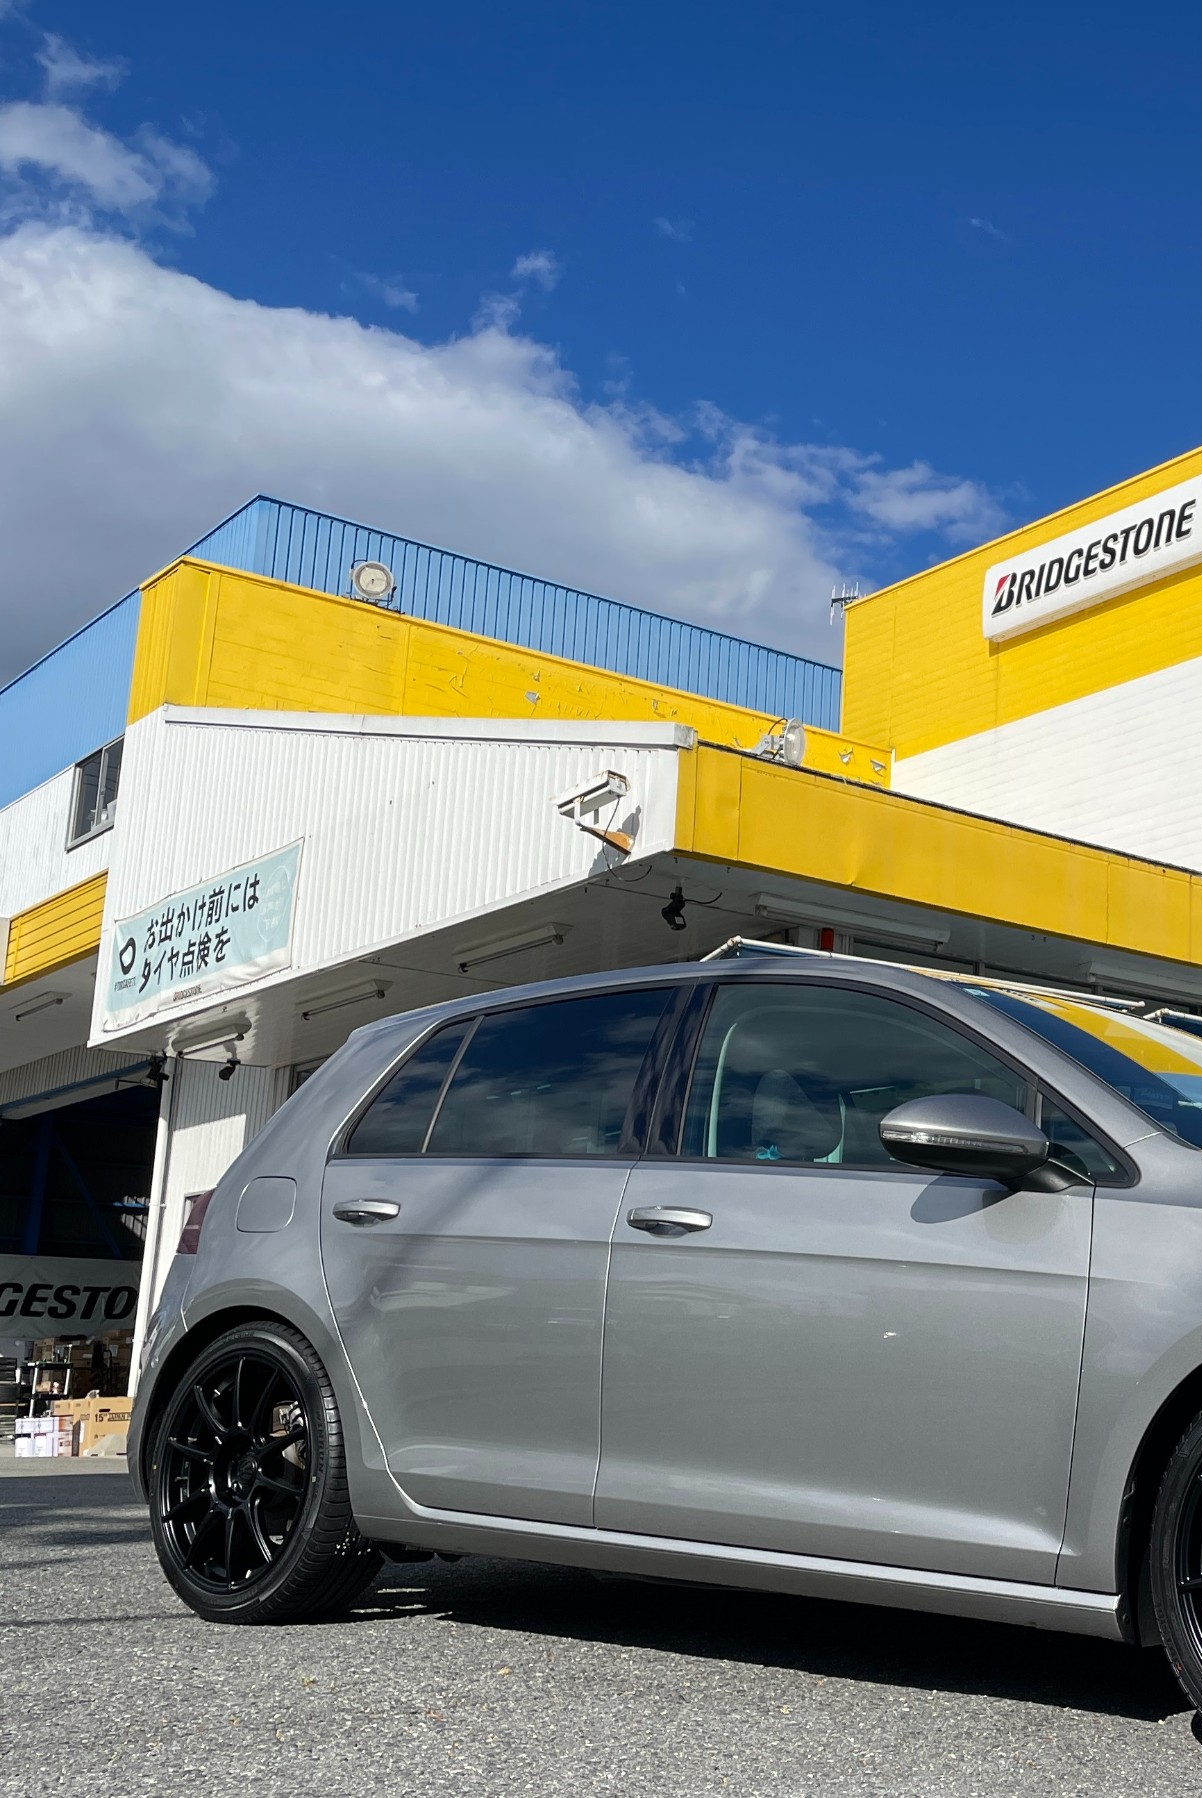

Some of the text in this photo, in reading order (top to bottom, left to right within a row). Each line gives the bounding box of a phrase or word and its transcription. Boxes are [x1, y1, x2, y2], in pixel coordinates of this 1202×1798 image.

[991, 498, 1197, 617] BRIDGESTONE
[144, 873, 260, 953] お出かけ前には
[138, 926, 231, 994] タイヤ点検を
